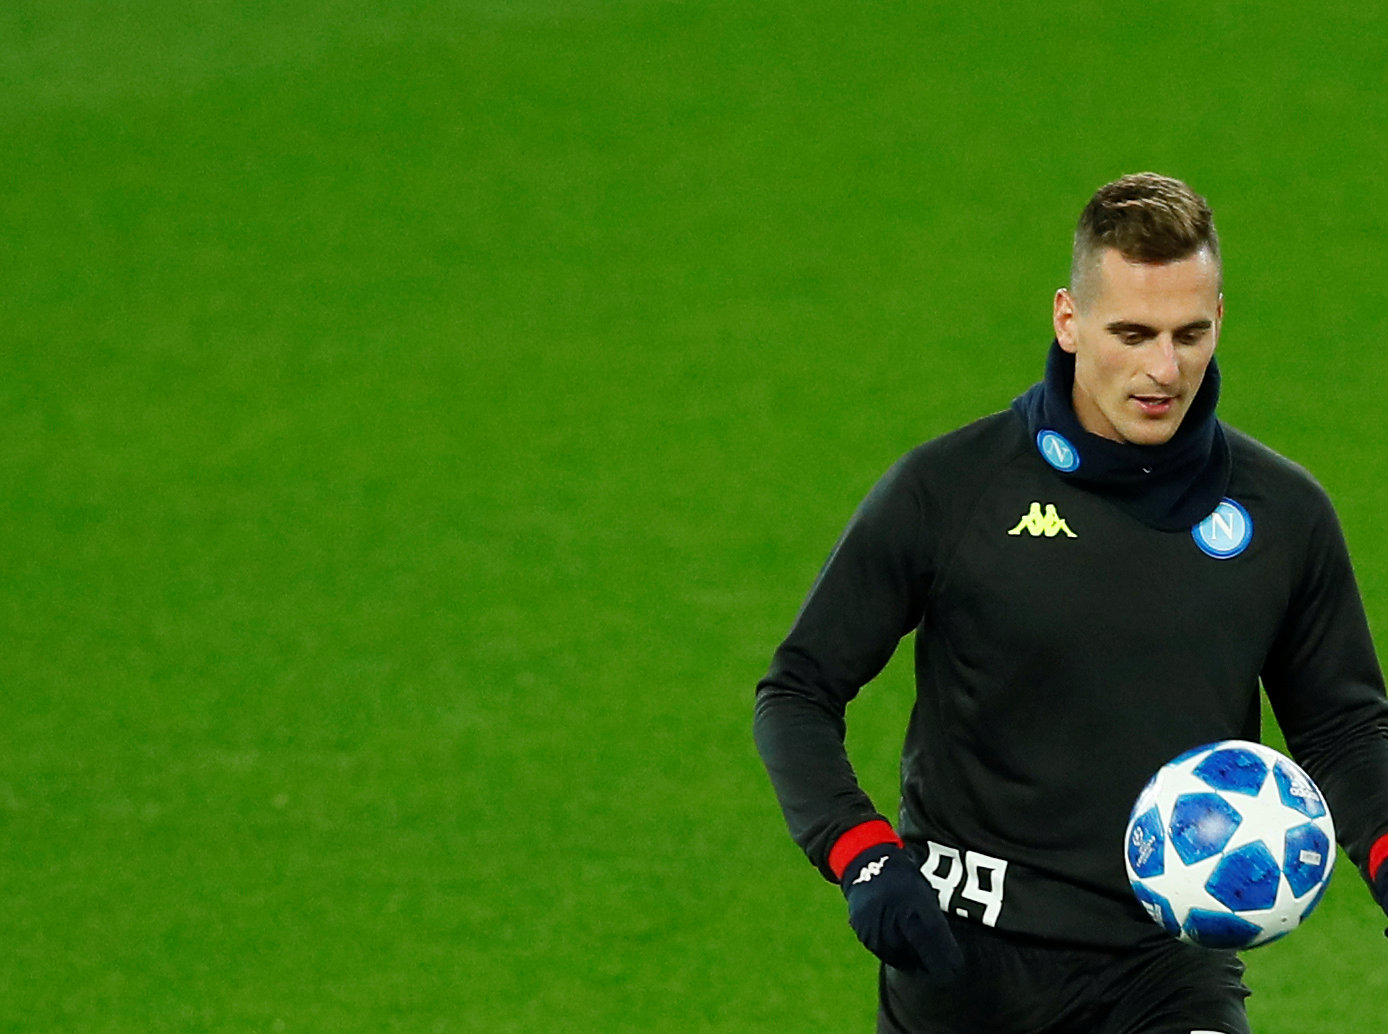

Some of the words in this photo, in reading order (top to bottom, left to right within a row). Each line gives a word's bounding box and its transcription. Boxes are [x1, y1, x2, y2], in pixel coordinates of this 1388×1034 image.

[1047, 438, 1069, 462] N
[1211, 512, 1234, 540] N
[920, 840, 1008, 928] 99
